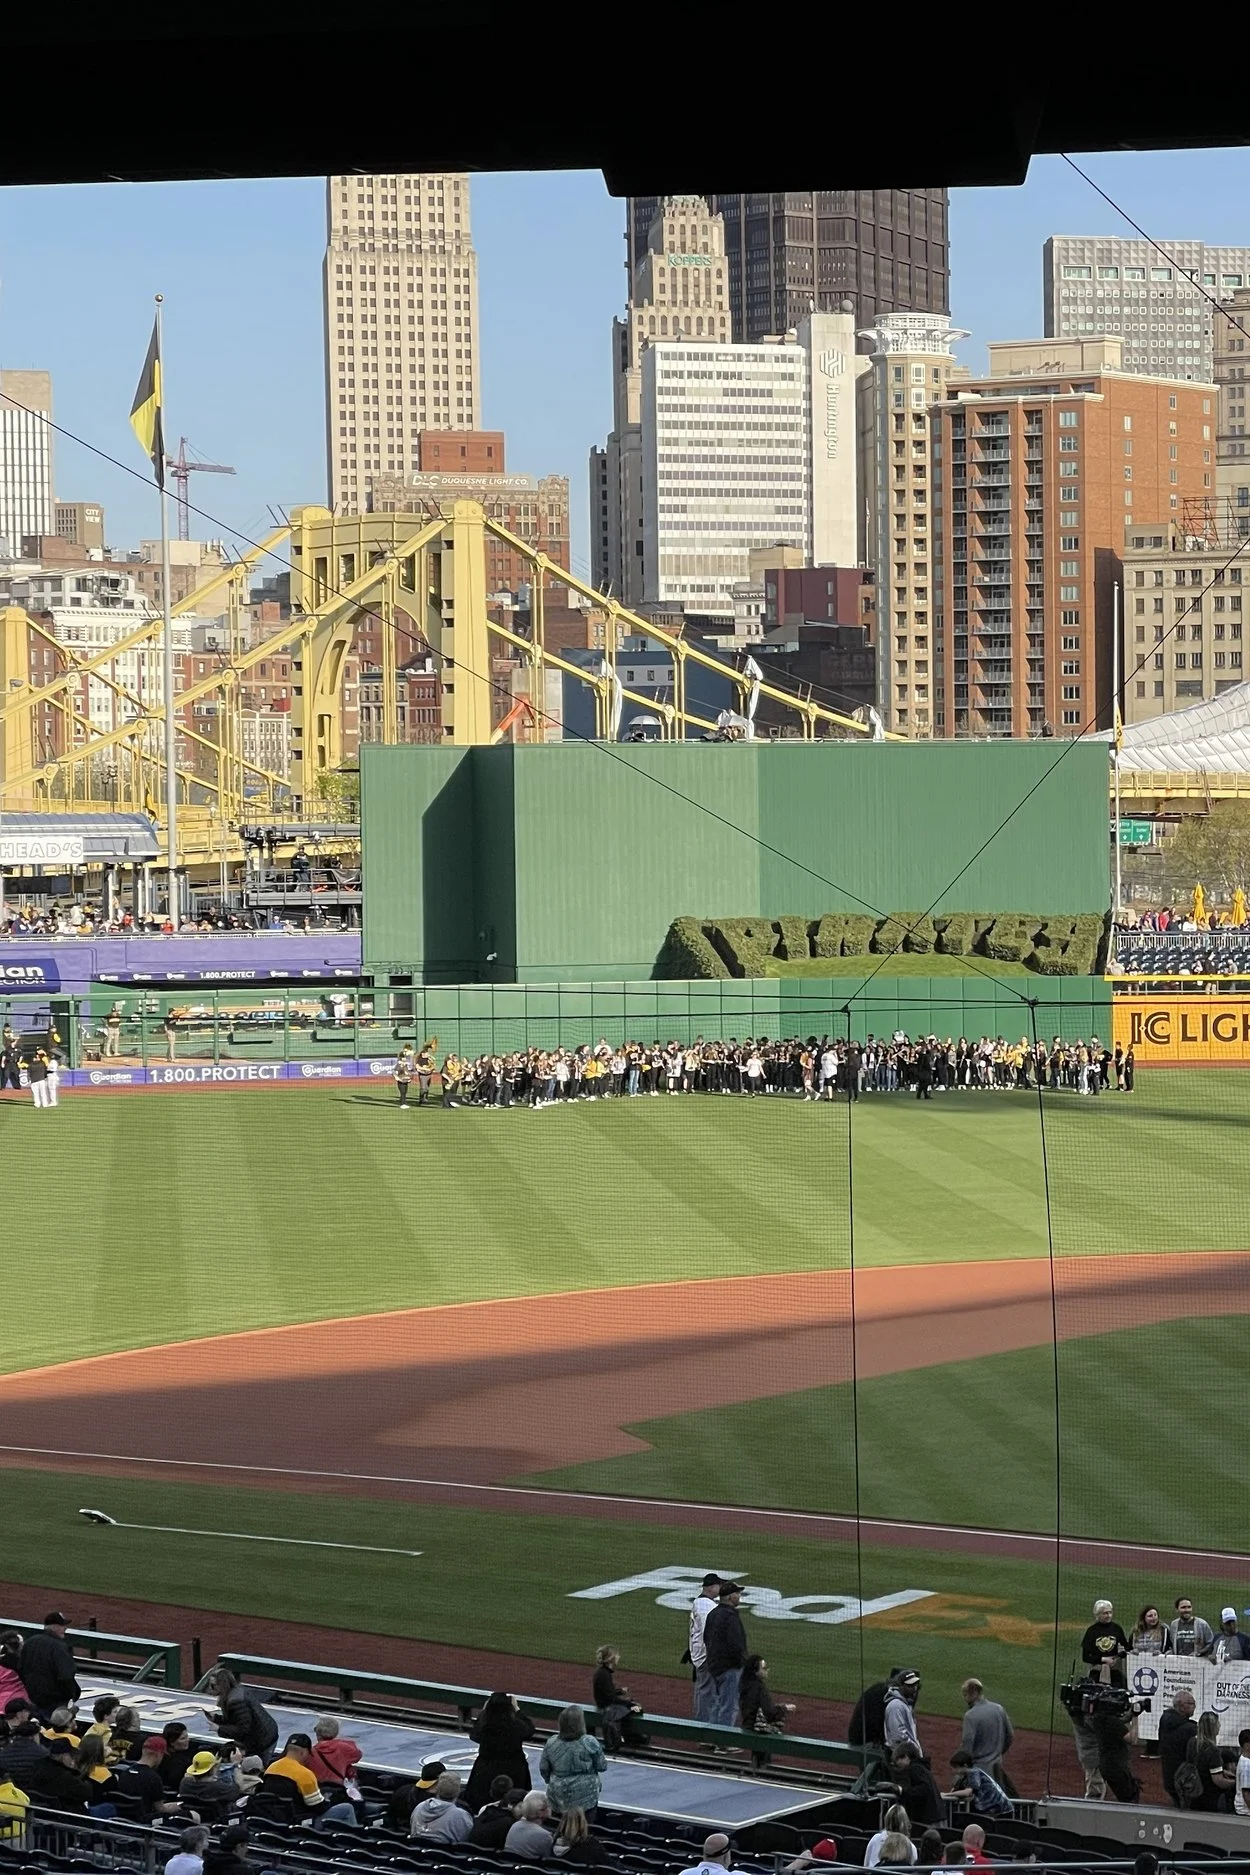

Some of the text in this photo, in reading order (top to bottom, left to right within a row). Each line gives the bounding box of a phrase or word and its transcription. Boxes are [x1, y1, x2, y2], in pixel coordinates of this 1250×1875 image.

[668, 254, 712, 266] KOPPERS
[824, 384, 840, 459] Huntington
[441, 477, 487, 485] DUQUESNE
[515, 478, 529, 486] CO.
[1, 842, 83, 858] HEAD'S
[200, 971, 256, 979] 1.800.PROTECT
[1131, 1012, 1171, 1045] IC
[90, 1071, 132, 1083] Guardian
[150, 1065, 281, 1083] 1.800.PROTECT
[301, 1065, 342, 1077] Guardian
[1163, 1668, 1191, 1676] American
[1216, 1682, 1231, 1690] OUT
[1216, 1690, 1250, 1699] DARKNESS
